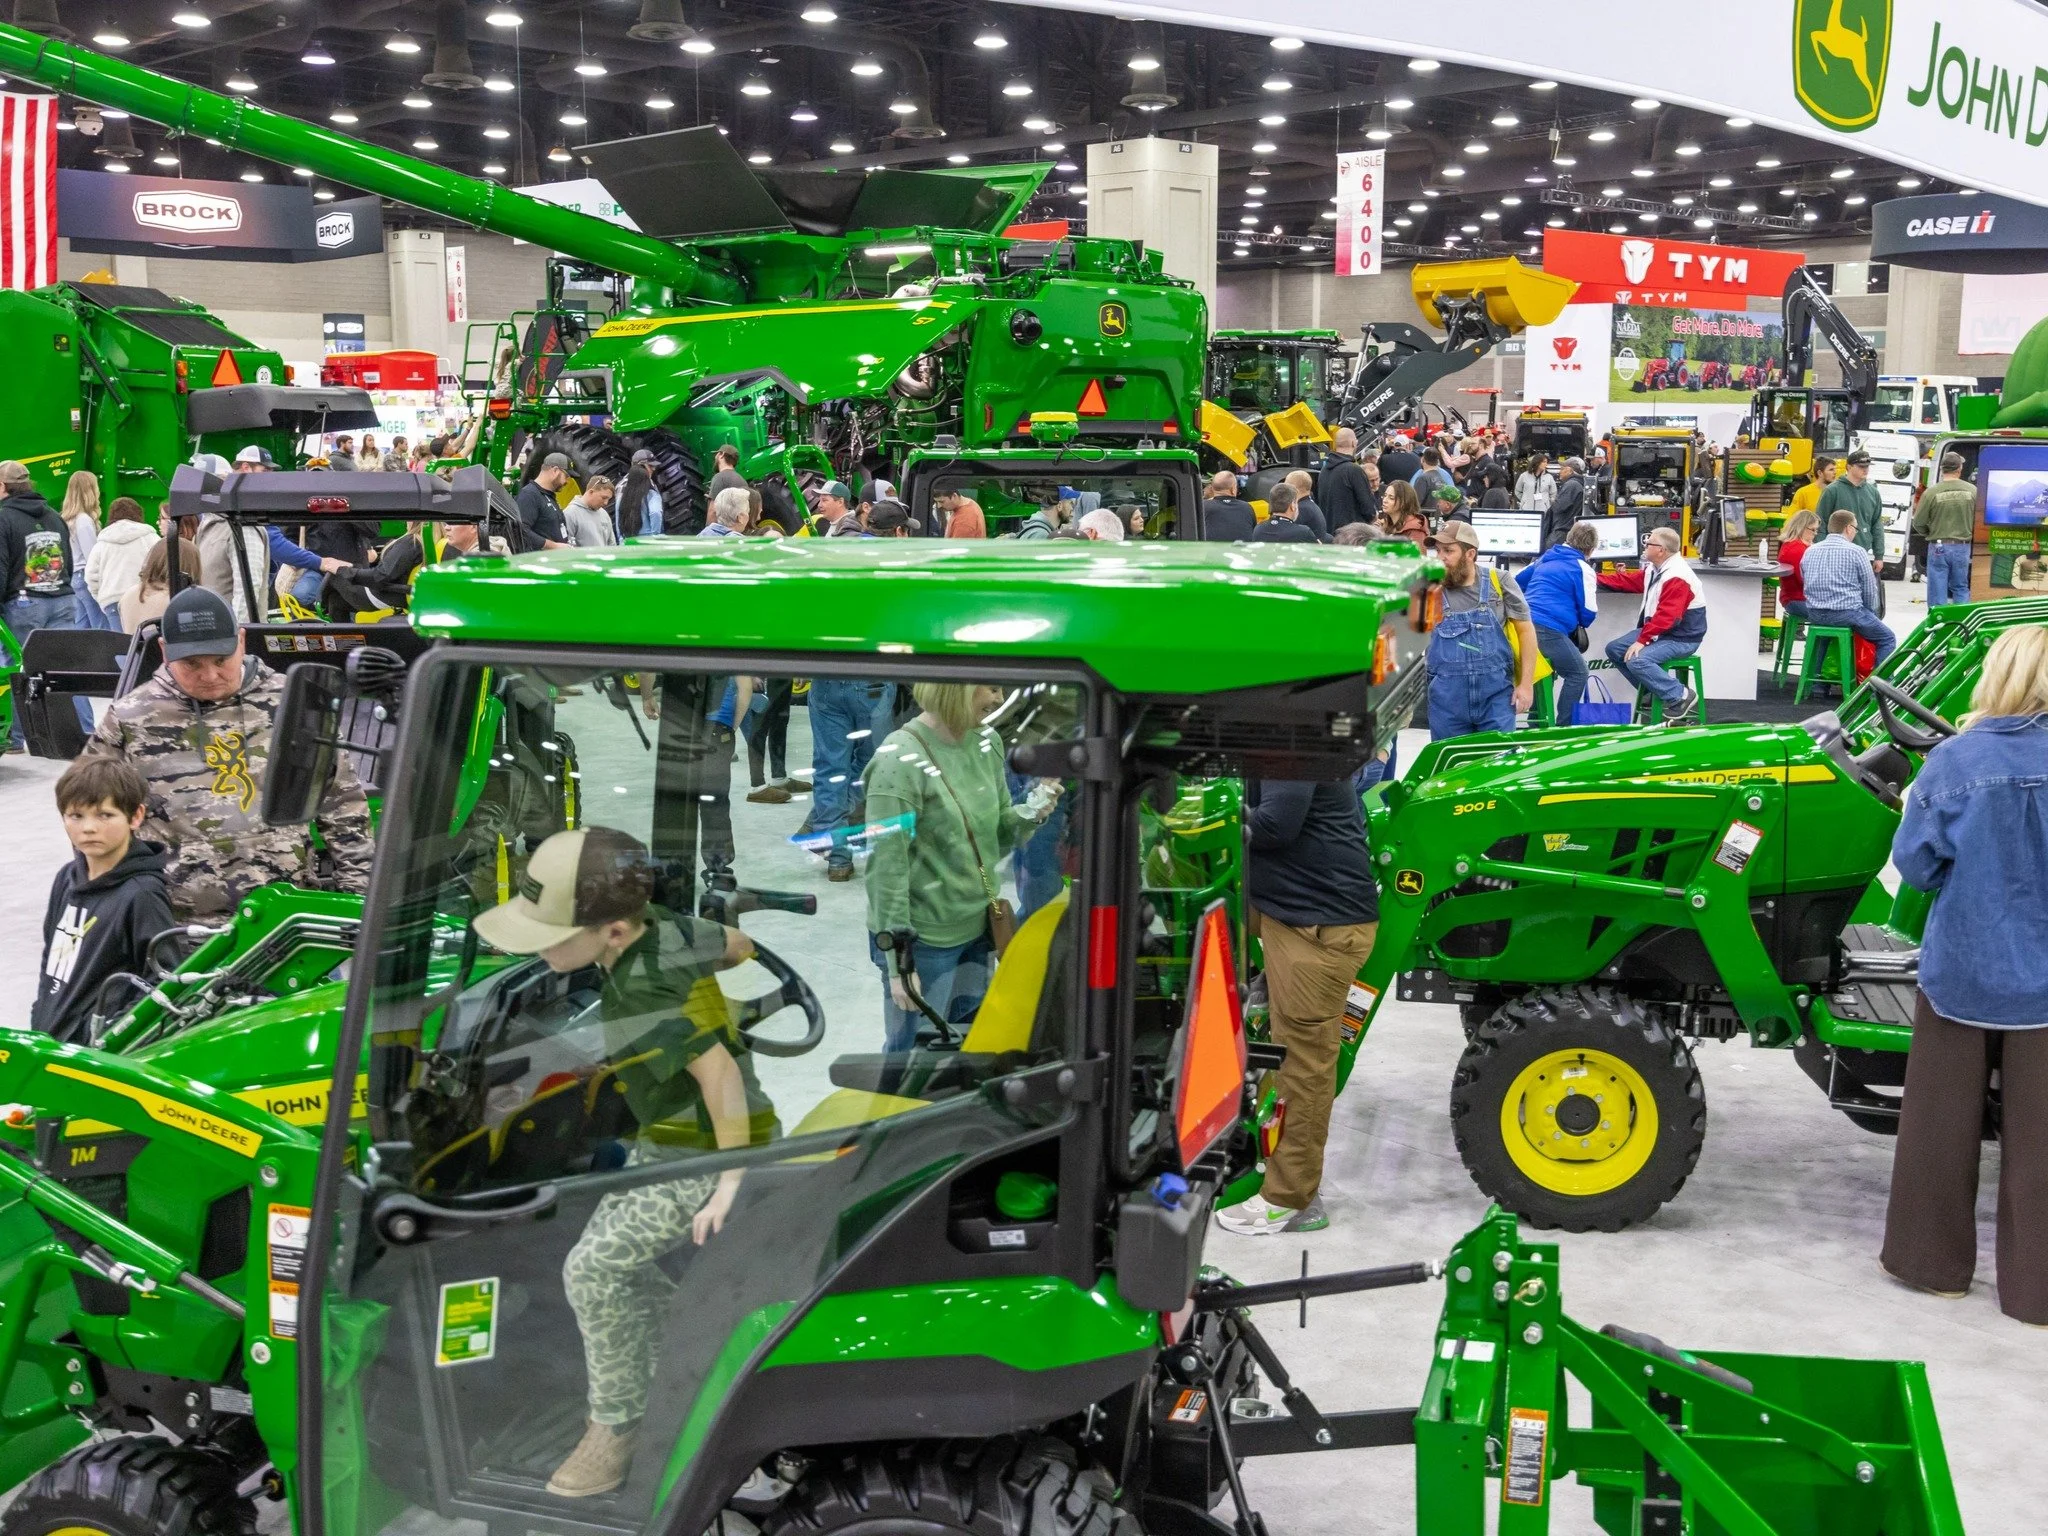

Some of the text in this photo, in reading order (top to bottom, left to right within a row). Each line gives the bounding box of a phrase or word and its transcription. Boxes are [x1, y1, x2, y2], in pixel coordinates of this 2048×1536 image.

[1907, 20, 2024, 140] JOHN
[1355, 154, 1382, 168] AISLE
[142, 202, 233, 221] BROCK
[319, 222, 350, 239] BROCK
[1906, 216, 1970, 237] CASE
[1668, 252, 1749, 284] TYM
[1641, 292, 1688, 303] TYM
[603, 322, 655, 332] JOHN DEERE
[1672, 315, 1764, 338] Get More. Do More.
[1830, 333, 1851, 360] DEERE
[1360, 387, 1394, 418] DEERE
[1452, 800, 1497, 815] 300 E
[266, 1095, 321, 1115] JOHN
[156, 1102, 249, 1147] JOHN DEERE
[70, 1146, 97, 1167] 1M
